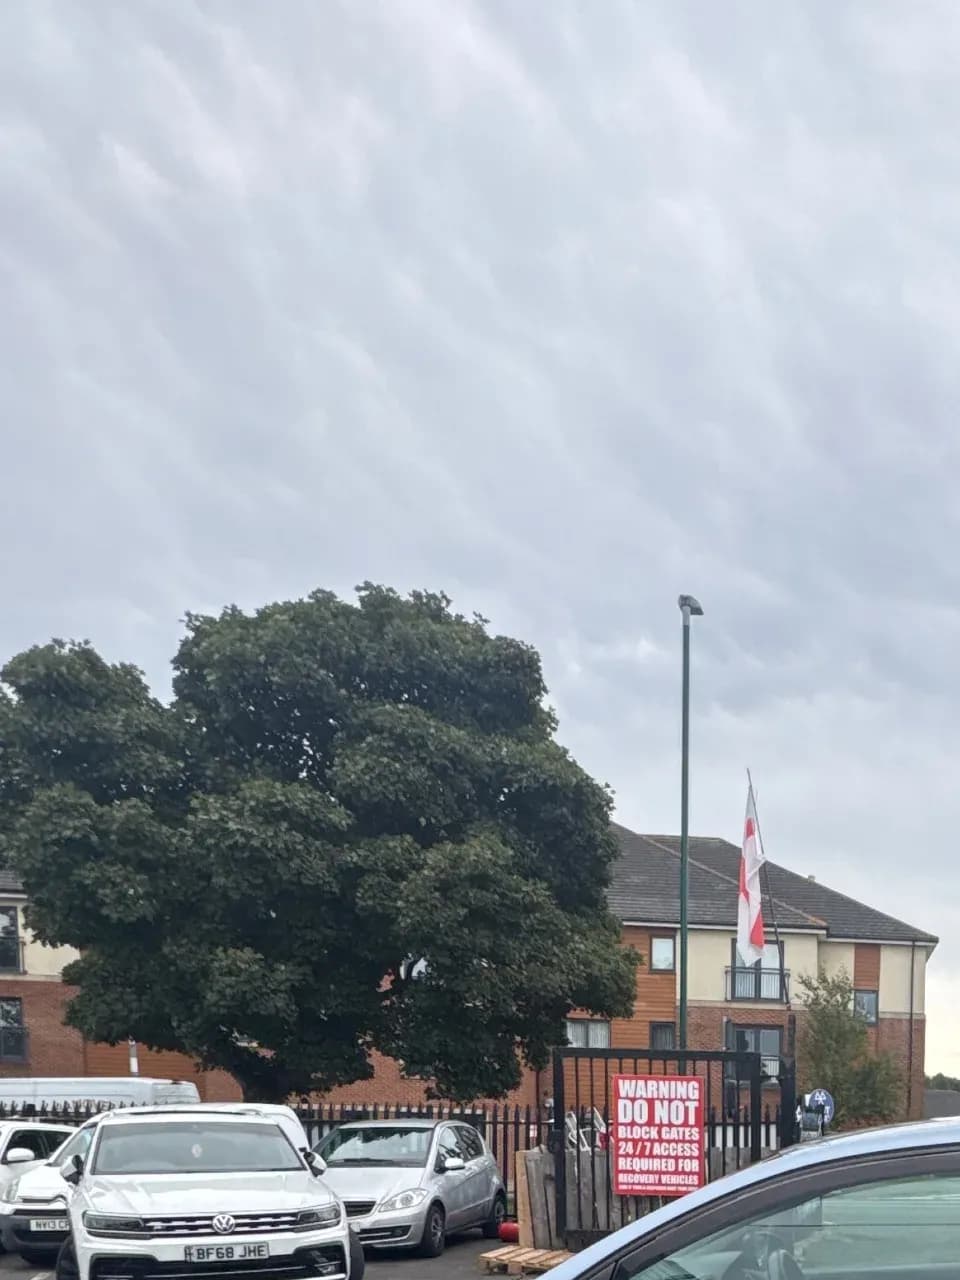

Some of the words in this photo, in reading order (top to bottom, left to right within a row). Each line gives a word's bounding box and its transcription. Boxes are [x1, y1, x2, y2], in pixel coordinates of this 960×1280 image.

[618, 1079, 700, 1100] WARNING
[618, 1099, 649, 1124] DO
[654, 1101, 699, 1125] NOT
[618, 1126, 658, 1139] BLOCK
[661, 1127, 700, 1141] GATES
[652, 1142, 700, 1157] ACCESS
[618, 1158, 676, 1172] REQUIRED
[678, 1159, 699, 1172] FOR
[618, 1174, 660, 1184] RECOVERY
[661, 1175, 699, 1185] VEHICLES
[196, 1246, 235, 1260] BF68
[238, 1245, 267, 1258] JHE
